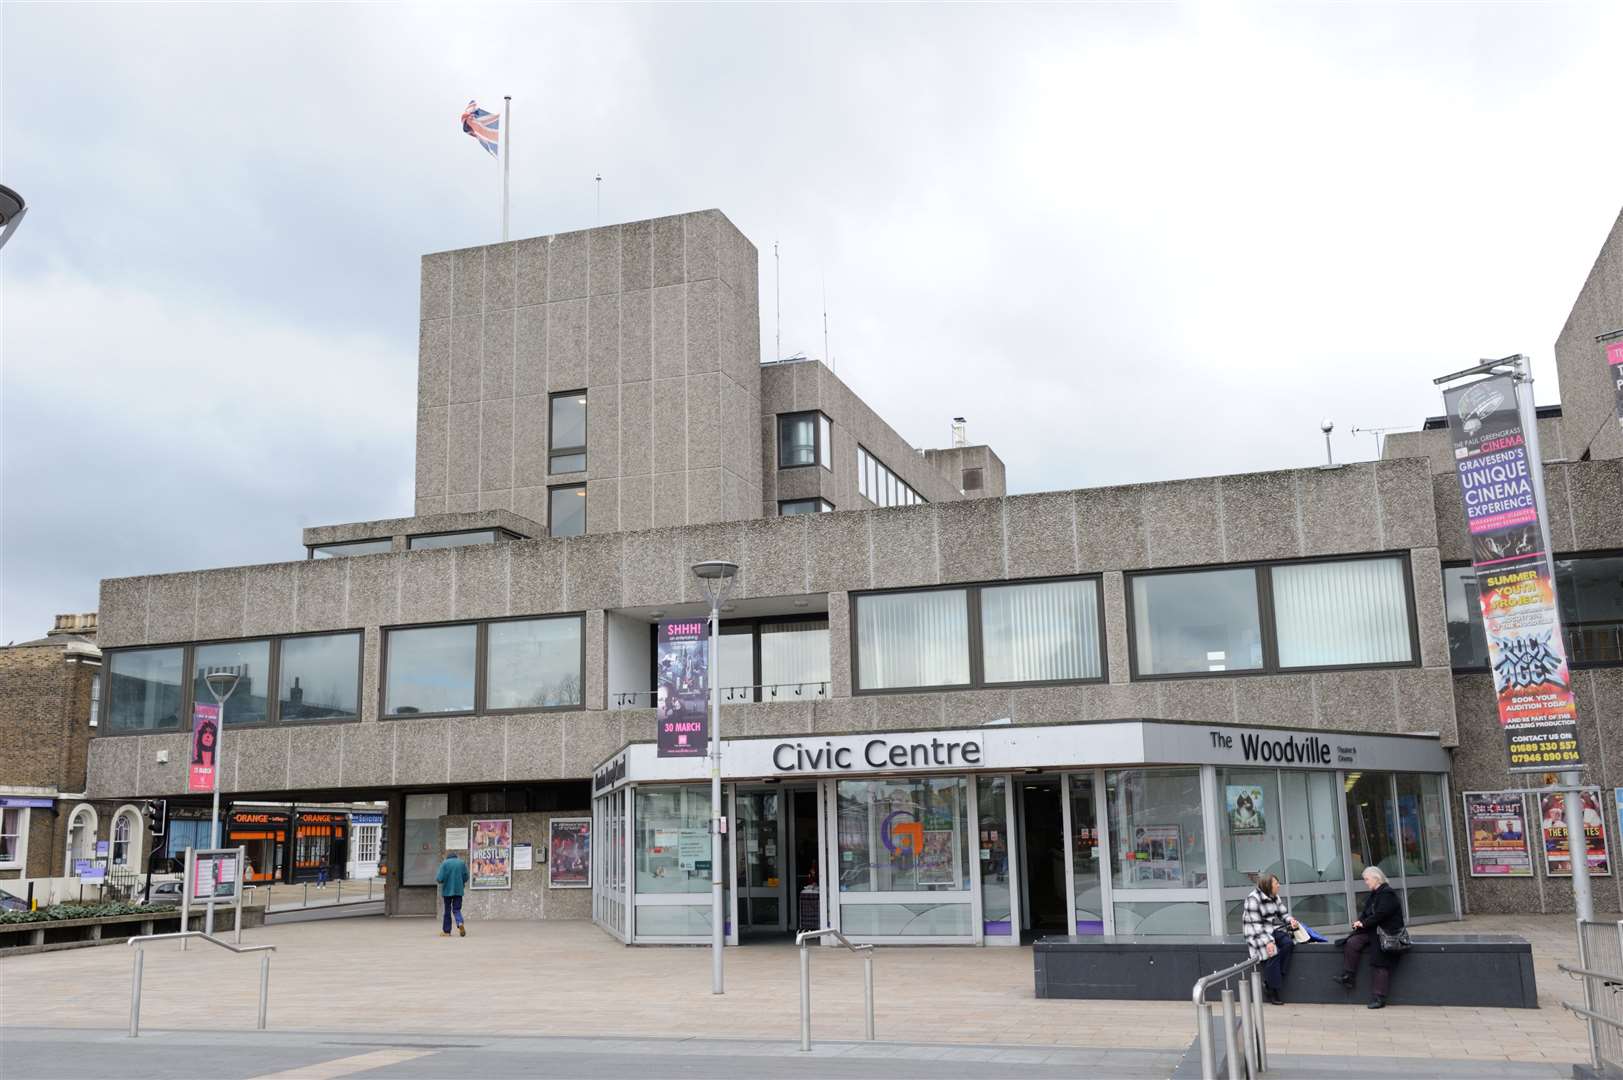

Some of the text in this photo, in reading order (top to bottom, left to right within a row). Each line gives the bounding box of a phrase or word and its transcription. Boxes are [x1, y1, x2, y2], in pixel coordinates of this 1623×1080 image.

[1465, 438, 1479, 446] PAUL
[1480, 427, 1521, 441] GREENGRASS
[1481, 434, 1524, 453] CINEMA
[1459, 448, 1524, 472] GRAVESEND'S
[1461, 460, 1527, 489] UNIQUE
[1465, 478, 1531, 505] CINEMA
[1467, 494, 1533, 518] EXPERIENCE
[1487, 570, 1537, 586] SUMMER
[1495, 582, 1537, 595] YOUTH
[1512, 695, 1534, 703] BOOK
[1505, 702, 1542, 711] AUDITION
[664, 722, 701, 732] 30 MARCH
[1504, 720, 1576, 730] AMAZING PRODUCTION
[1512, 734, 1547, 742] CONTACT
[1210, 731, 1331, 764] The Woodville
[1540, 742, 1557, 751] 330
[772, 737, 981, 771] Civic Centre
[236, 814, 269, 823] ORANGE
[303, 814, 331, 822] ORANGE
[1549, 827, 1563, 837] THE
